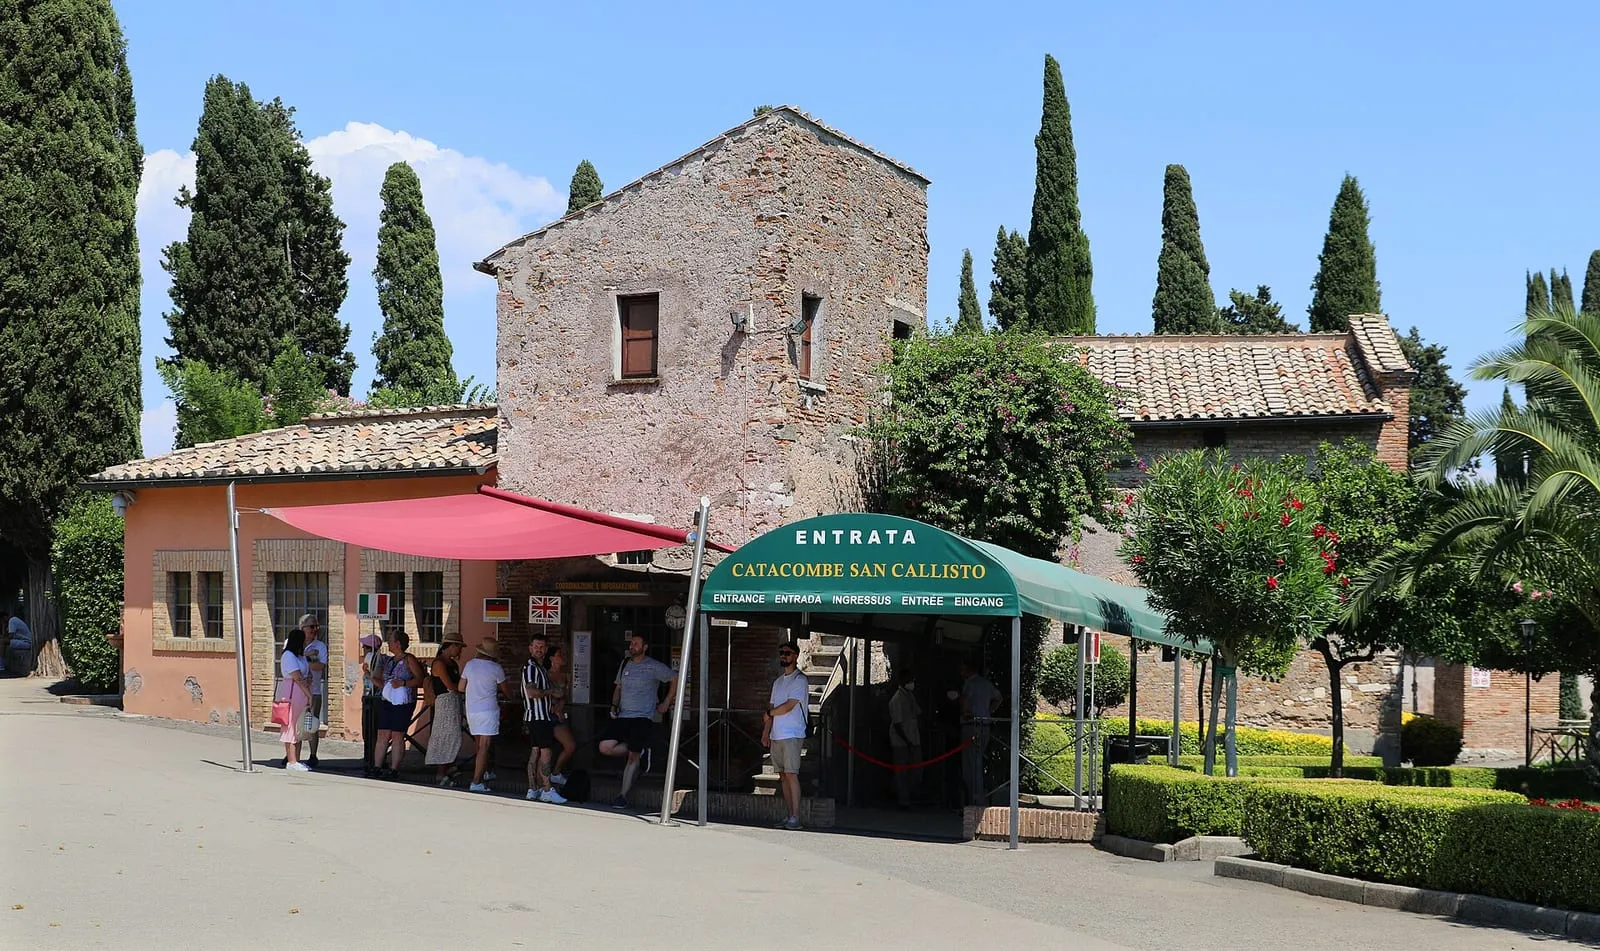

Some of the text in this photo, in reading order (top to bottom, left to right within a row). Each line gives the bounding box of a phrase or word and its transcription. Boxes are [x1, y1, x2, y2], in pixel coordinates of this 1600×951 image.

[795, 530, 917, 545] ENTRATA
[731, 562, 986, 579] CATACOMBE SAN CALLISTO
[713, 593, 1004, 607] ENTRANCE ENTRADA INGRESSUS ENTREE EINGANG
